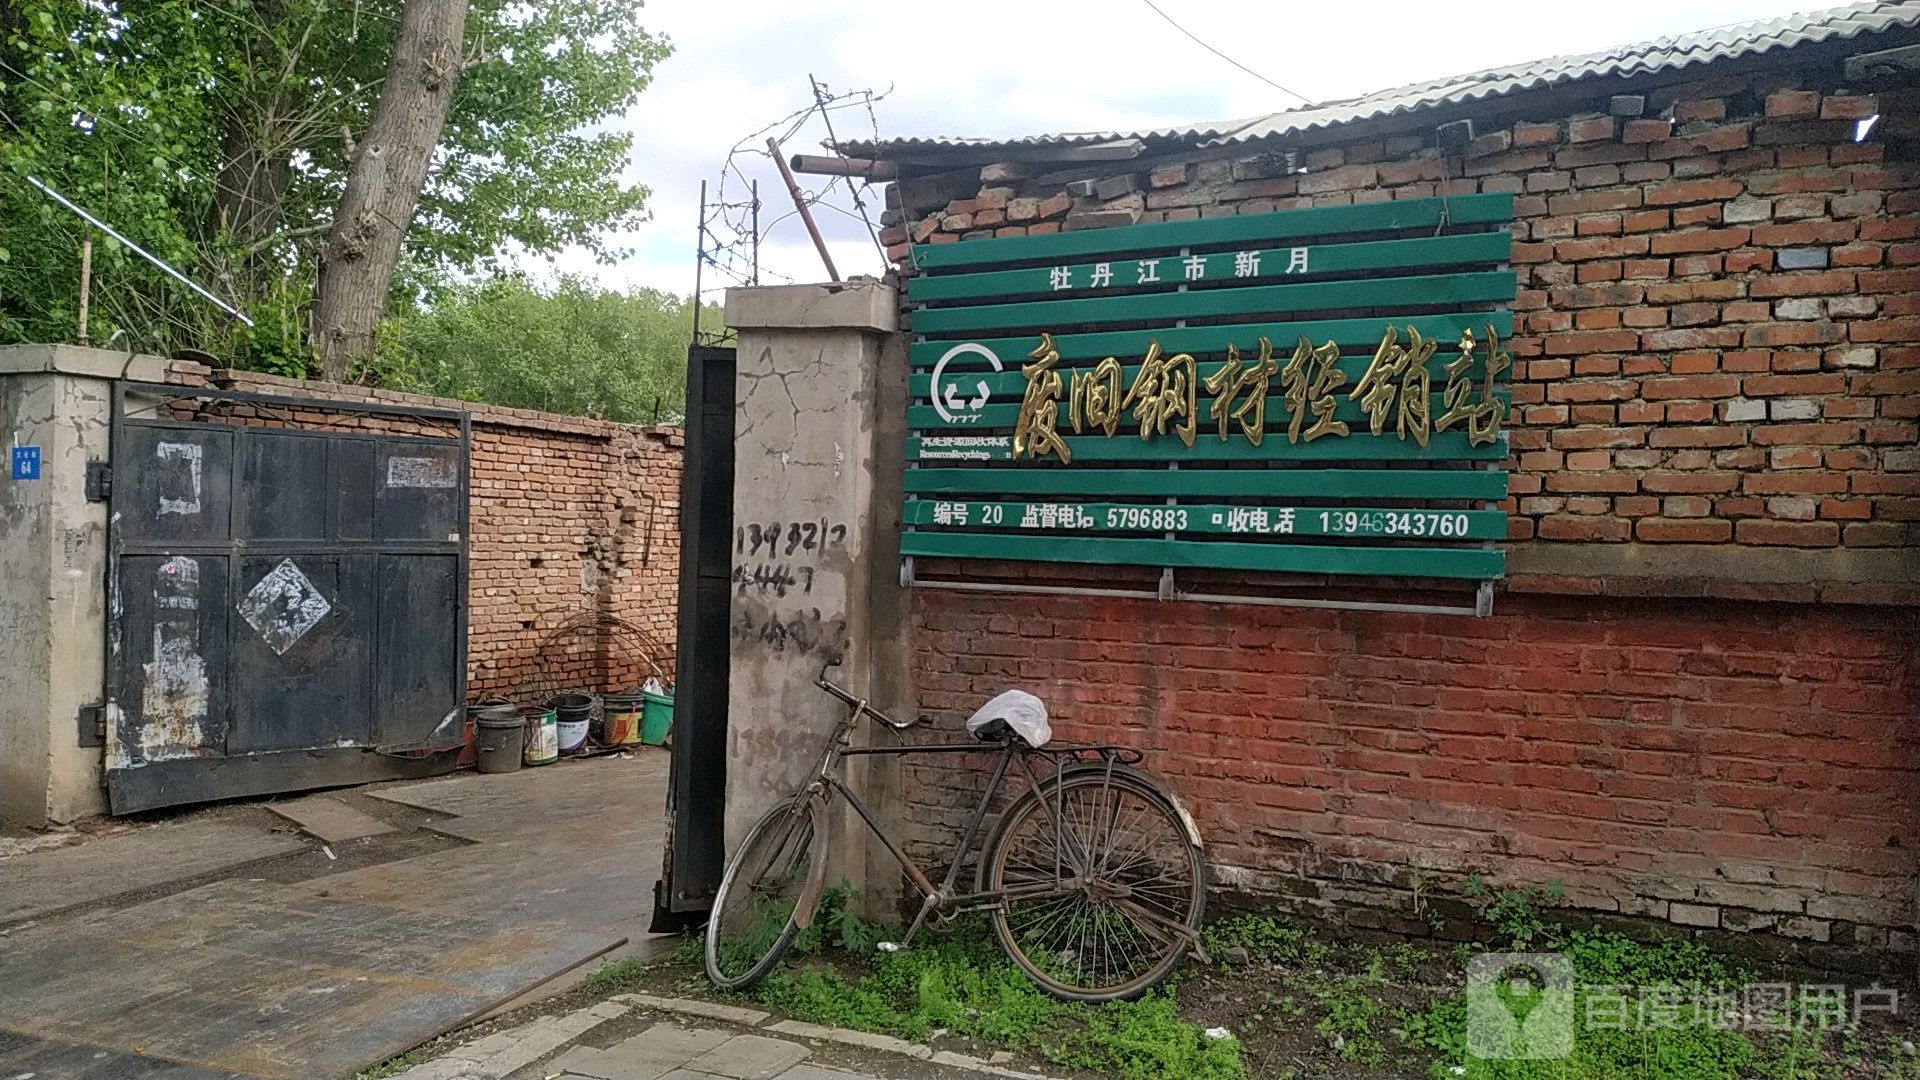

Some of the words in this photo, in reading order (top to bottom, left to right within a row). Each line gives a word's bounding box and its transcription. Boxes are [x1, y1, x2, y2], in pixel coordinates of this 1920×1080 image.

[1050, 247, 1309, 291] 牡丹江市新月
[1013, 322, 1511, 465] 废旧钢材经销站
[21, 461, 31, 474] 64
[933, 502, 969, 526] 编号
[981, 505, 1003, 524] 20
[1106, 507, 1188, 531] 5796883
[1319, 510, 1470, 537] 13946343760
